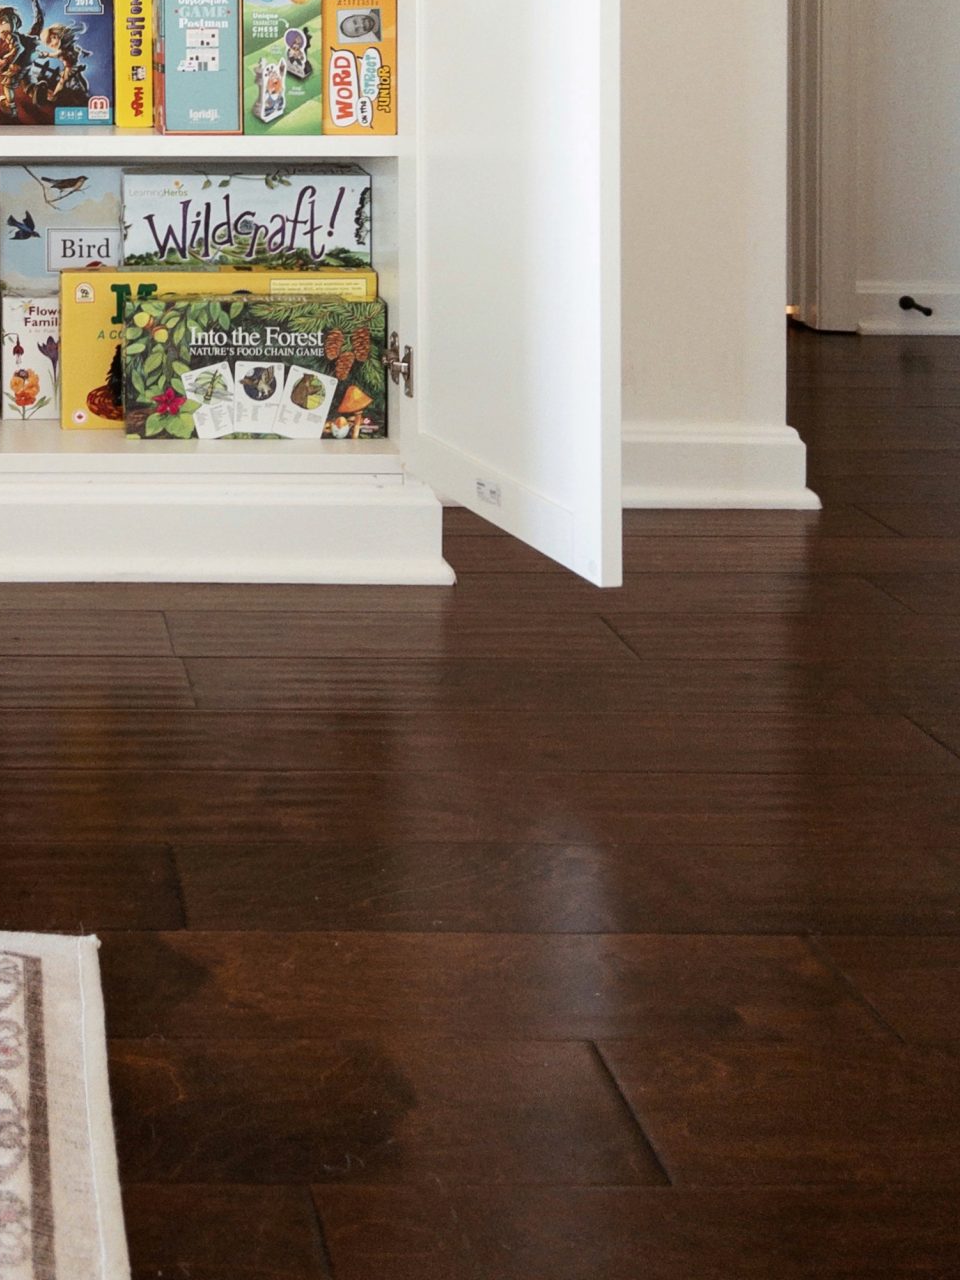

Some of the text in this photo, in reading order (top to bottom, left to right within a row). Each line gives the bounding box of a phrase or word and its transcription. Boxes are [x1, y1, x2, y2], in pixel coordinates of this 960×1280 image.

[179, 5, 228, 18] GAME
[252, 12, 279, 21] Unique
[177, 17, 229, 29] Postman
[125, 17, 146, 57] HERO
[333, 56, 353, 121] WORD
[376, 66, 391, 114] JUNIOR
[131, 86, 144, 117] HABA
[128, 186, 189, 198] LearningHerbs
[143, 184, 346, 262] Wildcraft!
[61, 237, 111, 259] Bird
[188, 327, 324, 347] Into the Forest
[188, 347, 325, 357] NATURE'S FOOD CHAIN GAME
